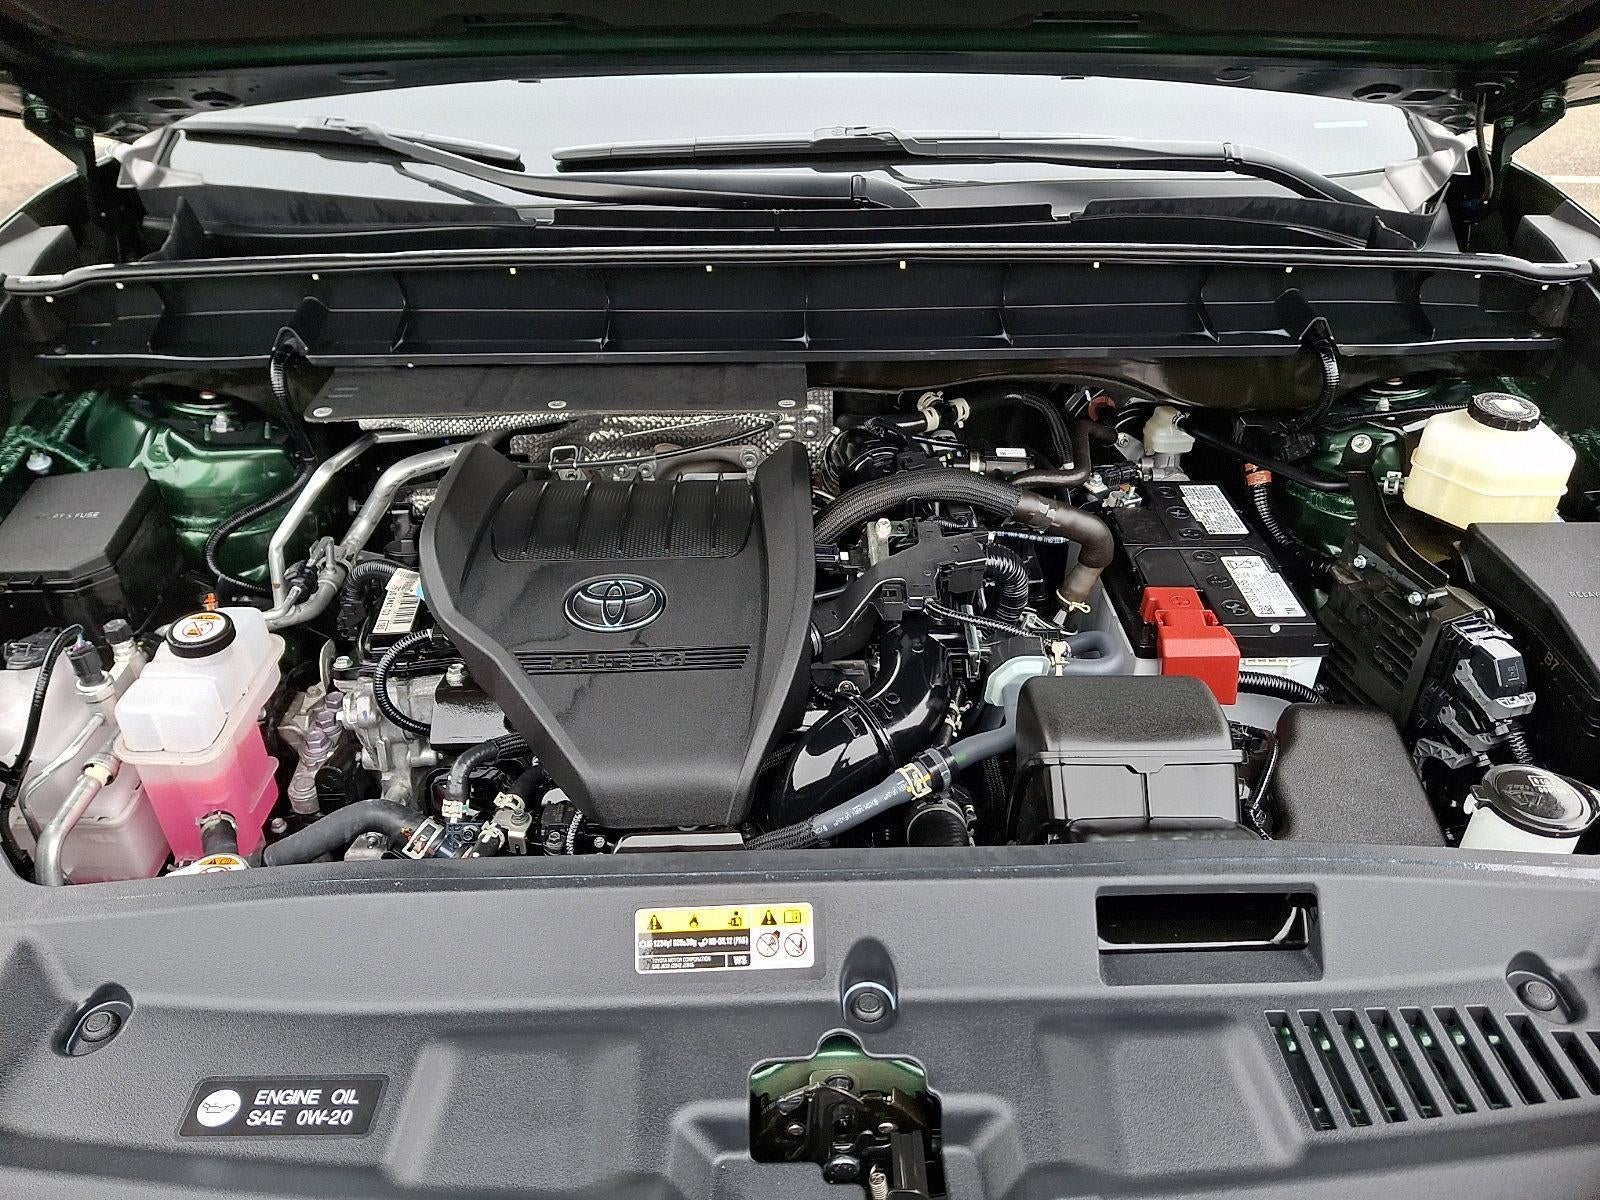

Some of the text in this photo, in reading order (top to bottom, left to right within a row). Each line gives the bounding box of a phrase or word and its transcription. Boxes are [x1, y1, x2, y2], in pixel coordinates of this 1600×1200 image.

[1568, 591, 1599, 599] RELAY
[253, 1088, 359, 1106] ENGINE OIL
[246, 1109, 354, 1126] SAE 0W-20
